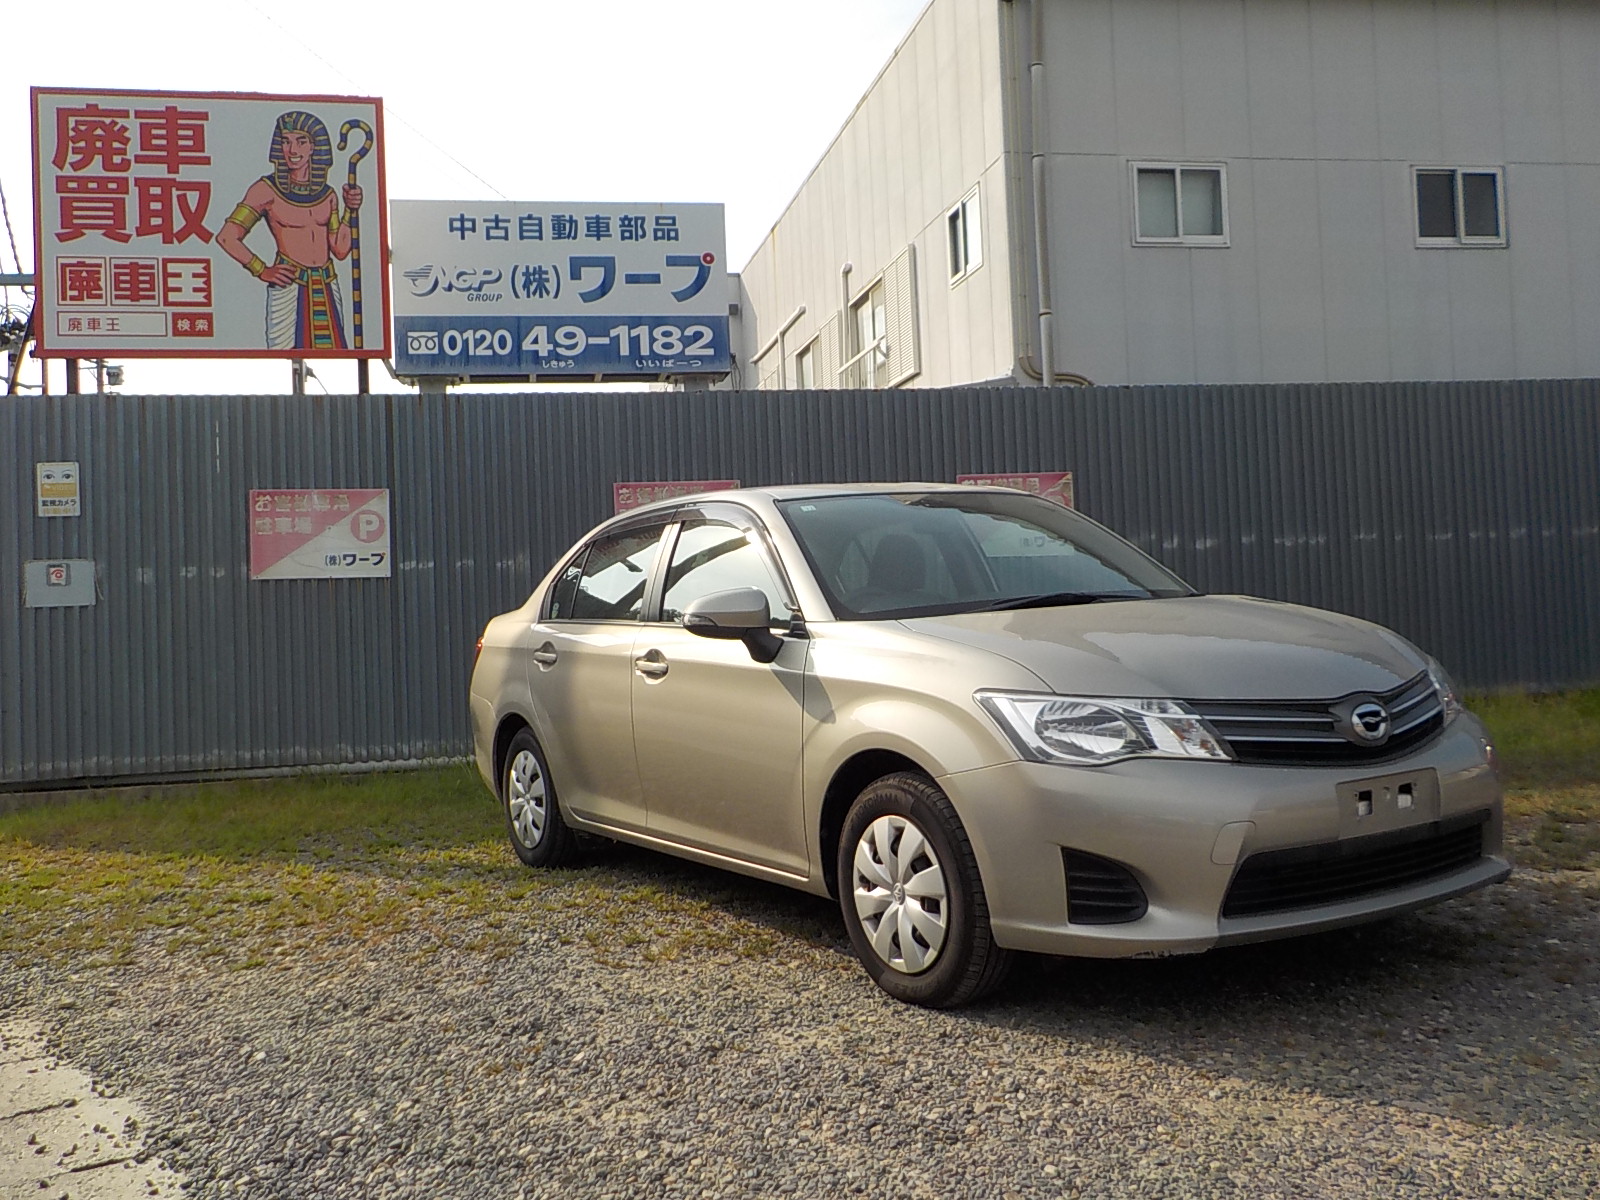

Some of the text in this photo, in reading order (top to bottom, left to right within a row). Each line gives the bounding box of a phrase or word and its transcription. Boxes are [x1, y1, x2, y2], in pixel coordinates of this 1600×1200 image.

[52, 103, 212, 175] 廃車
[54, 175, 215, 245] 買取
[449, 213, 680, 242] 中古自動車部品
[57, 257, 212, 307] 廃車王
[511, 252, 715, 304] (株)ワープ
[467, 292, 503, 302] GROUP
[67, 317, 121, 332] 廃車王
[176, 318, 210, 332] 検索
[442, 325, 715, 356] 0120 49-1182
[542, 359, 575, 368] しきゅう
[359, 514, 380, 540] P
